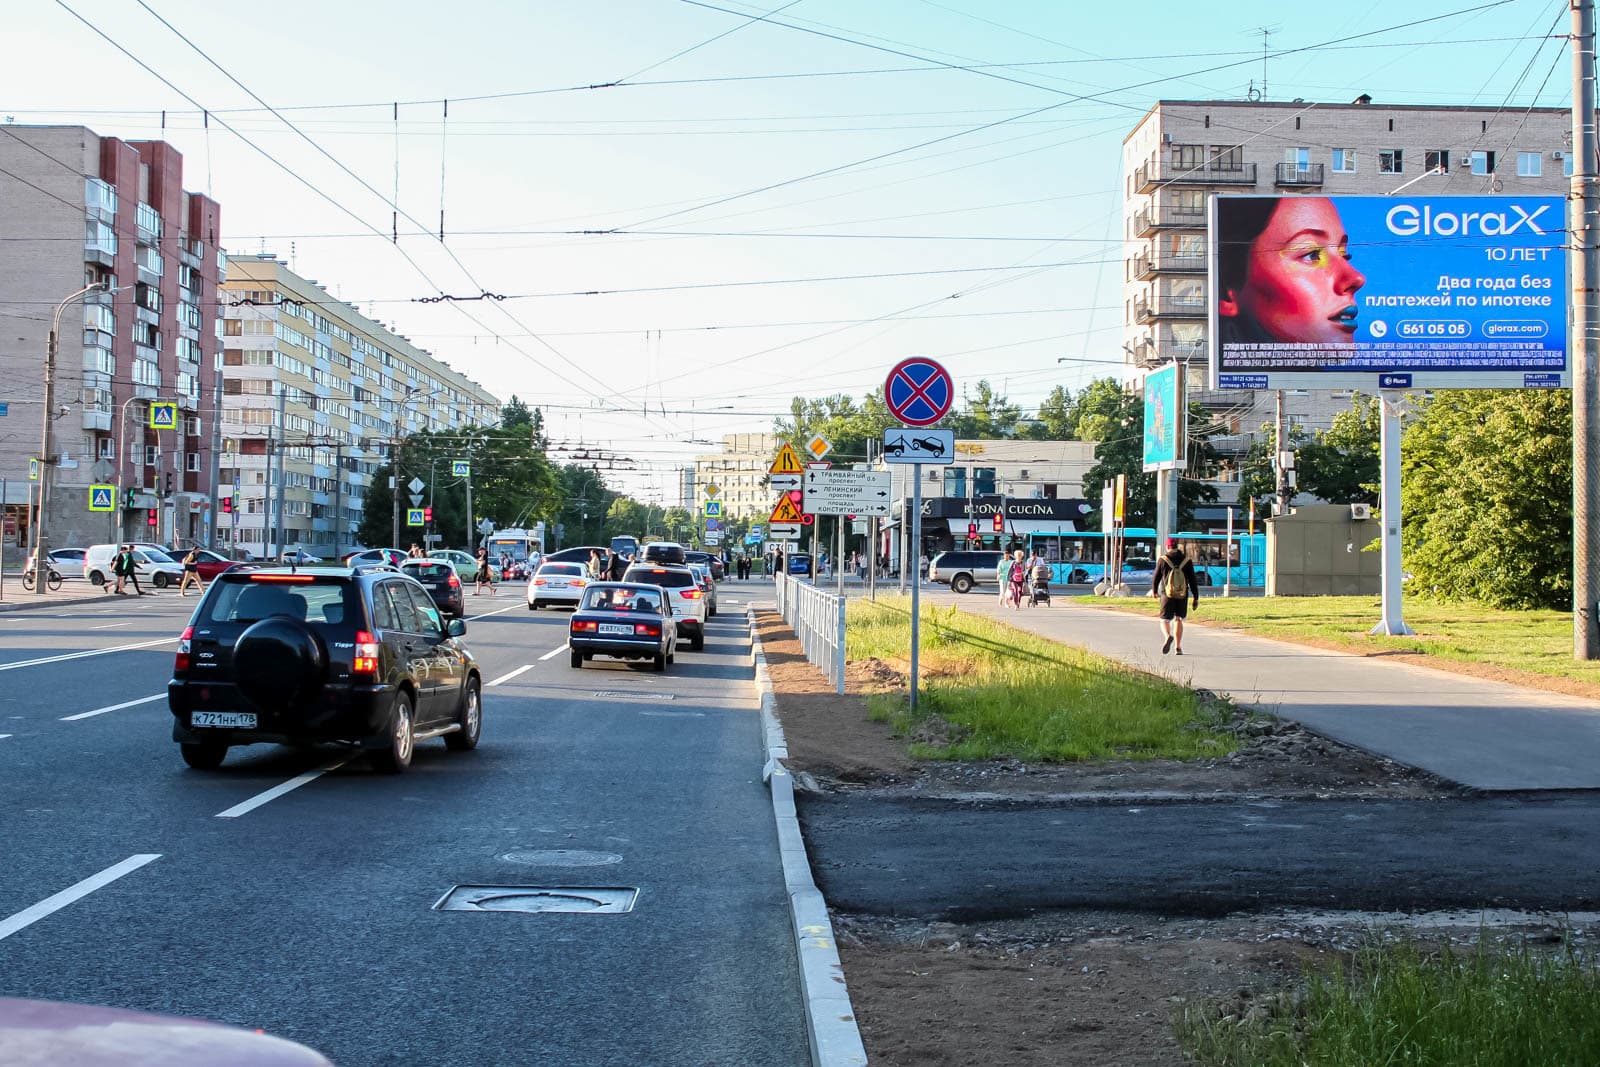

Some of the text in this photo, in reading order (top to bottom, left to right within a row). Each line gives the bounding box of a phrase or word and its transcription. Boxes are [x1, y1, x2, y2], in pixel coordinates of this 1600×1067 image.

[1385, 204, 1551, 236] GloraX
[1485, 248, 1552, 261] 10 ЛЕТ
[1437, 274, 1551, 290] Два года без
[1365, 293, 1551, 307] платежей по ипотеке
[1402, 325, 1465, 335] 561 05 05
[1488, 325, 1542, 336] glorax.com
[821, 471, 866, 479] ТРАМВАЙНЫЙ
[823, 485, 863, 493] ЛЕНИНСКИЙ
[1008, 504, 1053, 514] CUCINA
[195, 713, 236, 724] К721НН
